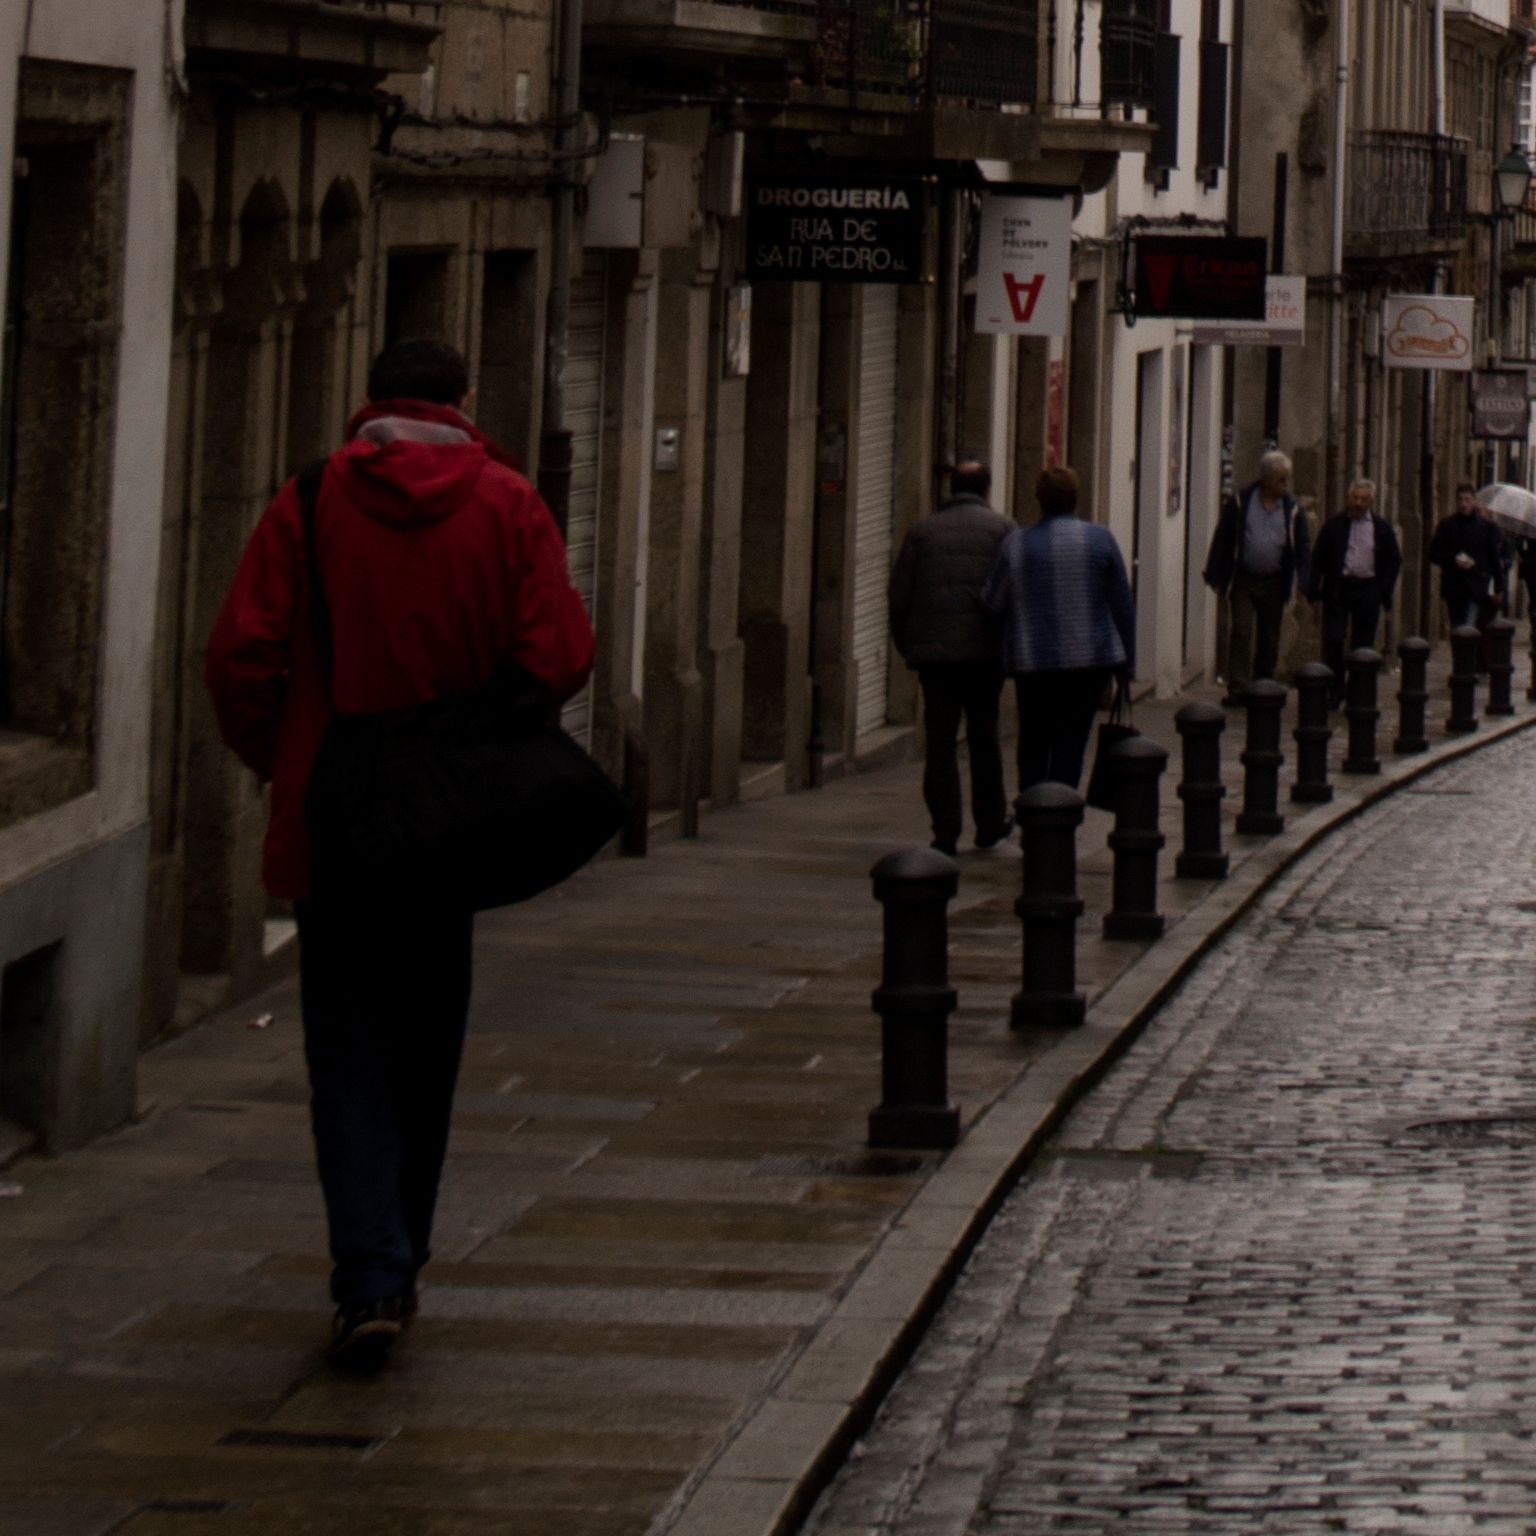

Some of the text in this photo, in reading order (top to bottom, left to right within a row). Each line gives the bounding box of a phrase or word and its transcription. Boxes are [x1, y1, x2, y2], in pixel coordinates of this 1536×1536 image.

[757, 185, 910, 210] DROGUERÍA
[790, 216, 878, 243] RUA DE
[811, 245, 892, 272] PEDRO
